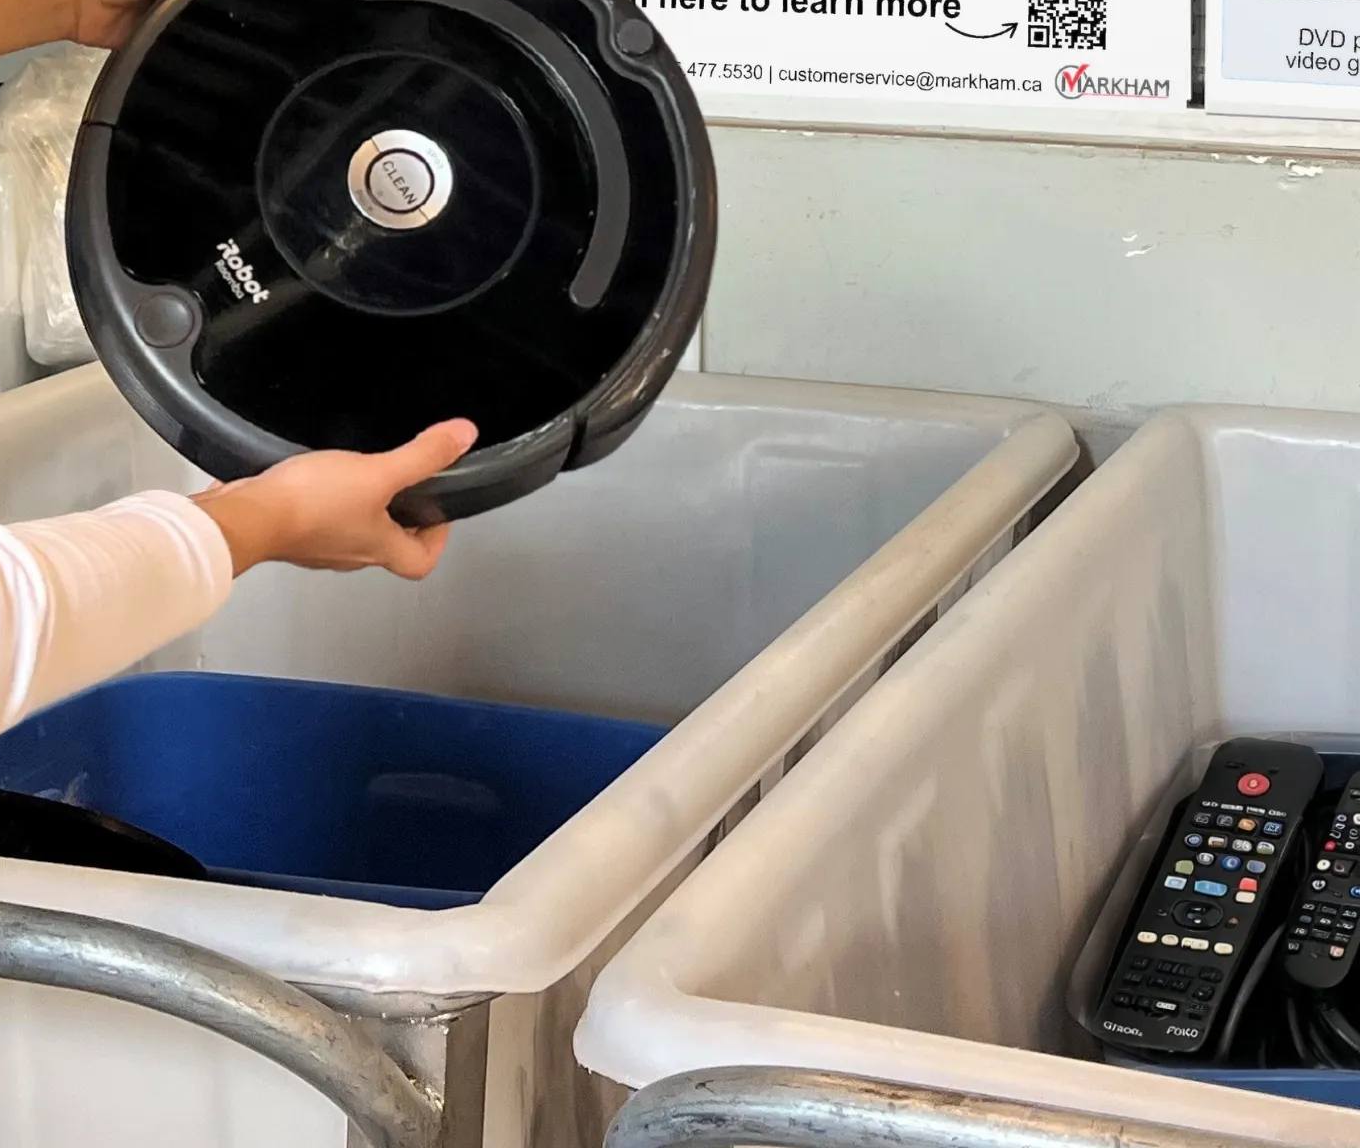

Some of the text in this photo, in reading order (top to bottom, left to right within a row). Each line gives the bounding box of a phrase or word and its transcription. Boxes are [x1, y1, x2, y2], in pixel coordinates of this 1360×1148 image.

[1298, 27, 1345, 54] DVD
[1286, 50, 1340, 70] video
[677, 61, 1042, 92] .477.5530 customerservice@markham.ca
[1060, 66, 1170, 97] MARKHAM
[380, 159, 418, 205] CLEAN
[216, 238, 270, 305] iRobot
